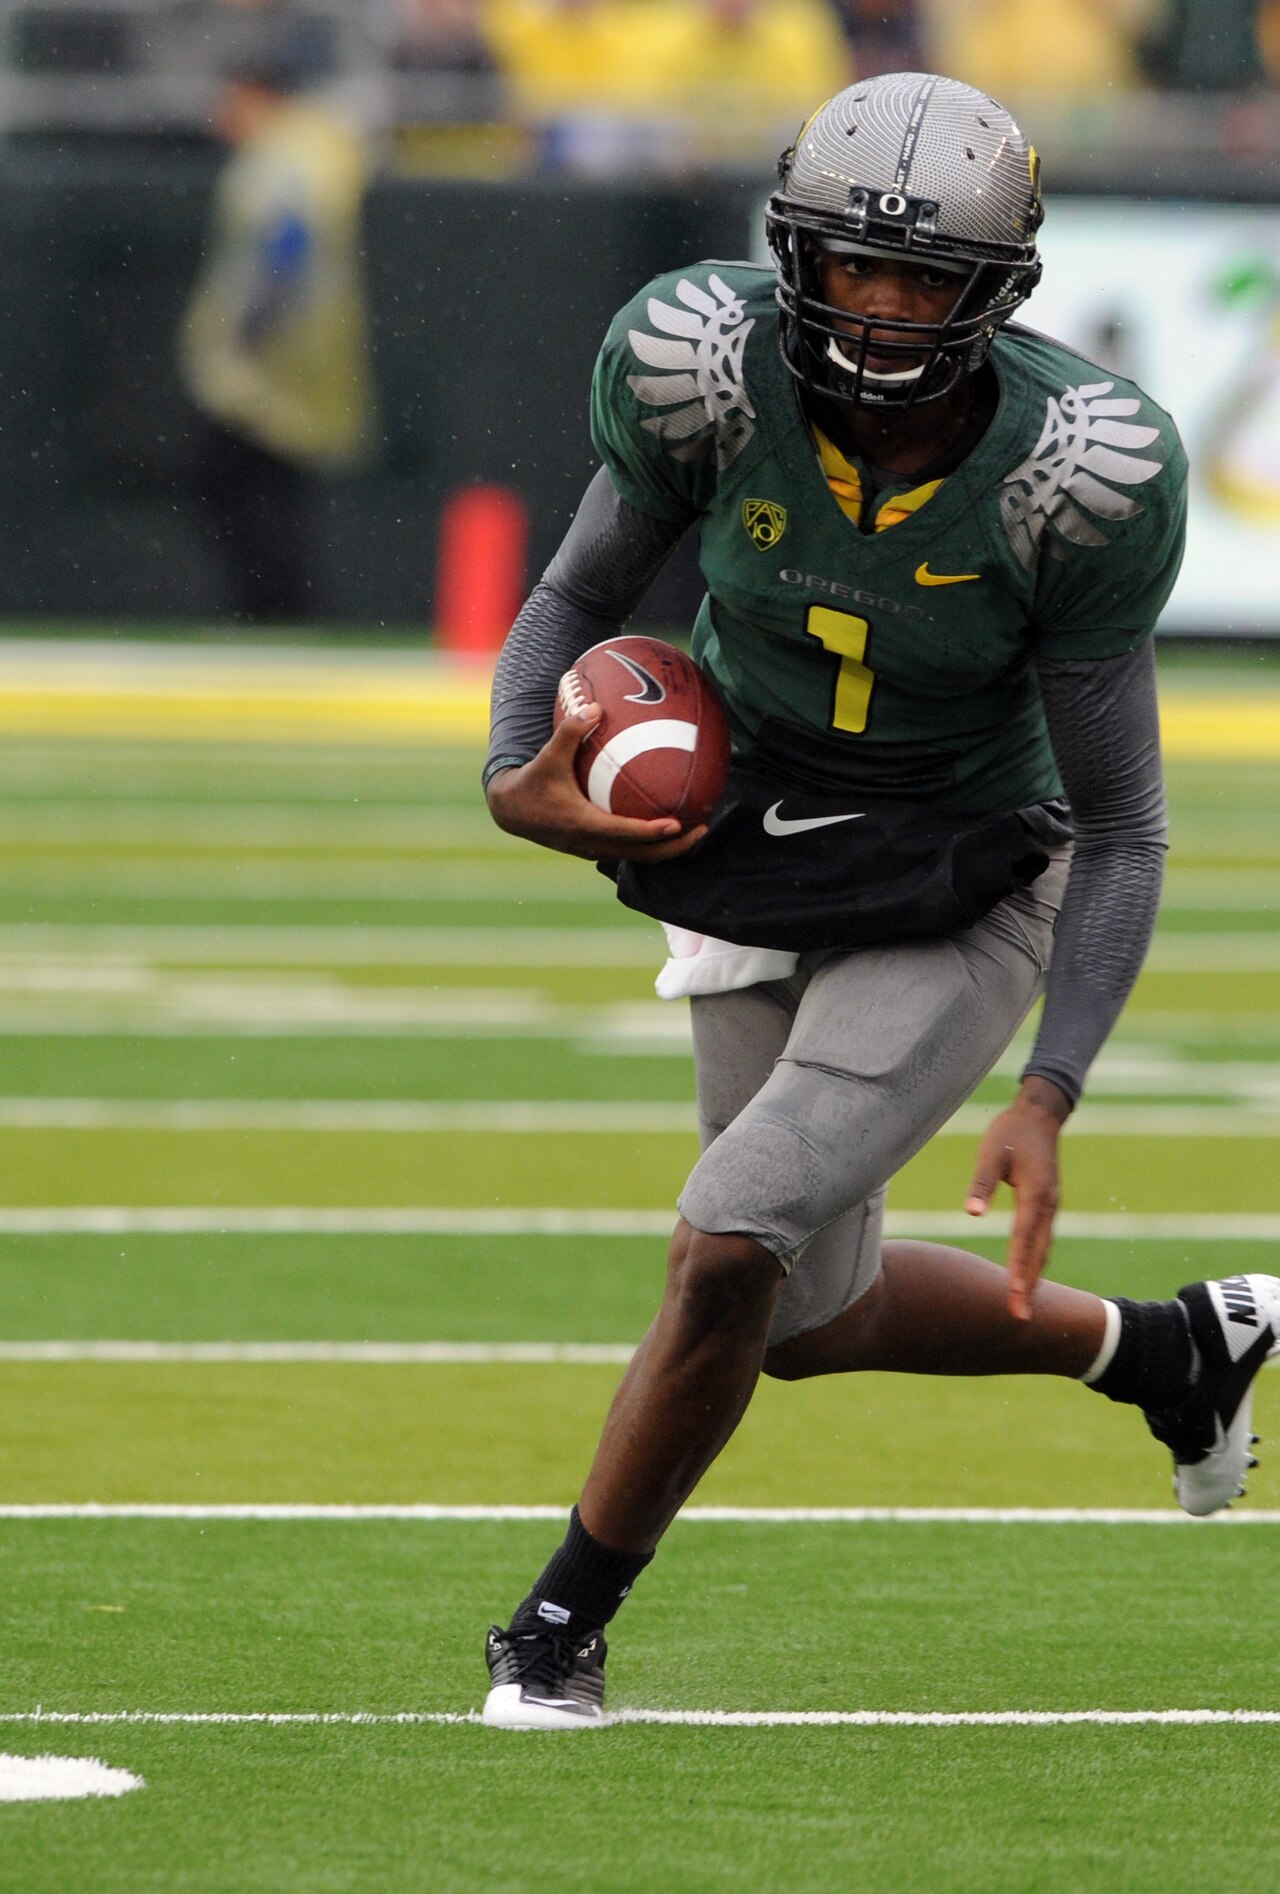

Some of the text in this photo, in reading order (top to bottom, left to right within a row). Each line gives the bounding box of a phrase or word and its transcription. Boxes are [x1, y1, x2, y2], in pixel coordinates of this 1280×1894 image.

[879, 194, 907, 216] O
[746, 502, 783, 537] PAC
[753, 521, 776, 541] 10
[779, 569, 929, 623] OREGON
[805, 603, 875, 735] 1
[1217, 1275, 1259, 1328] NIK
